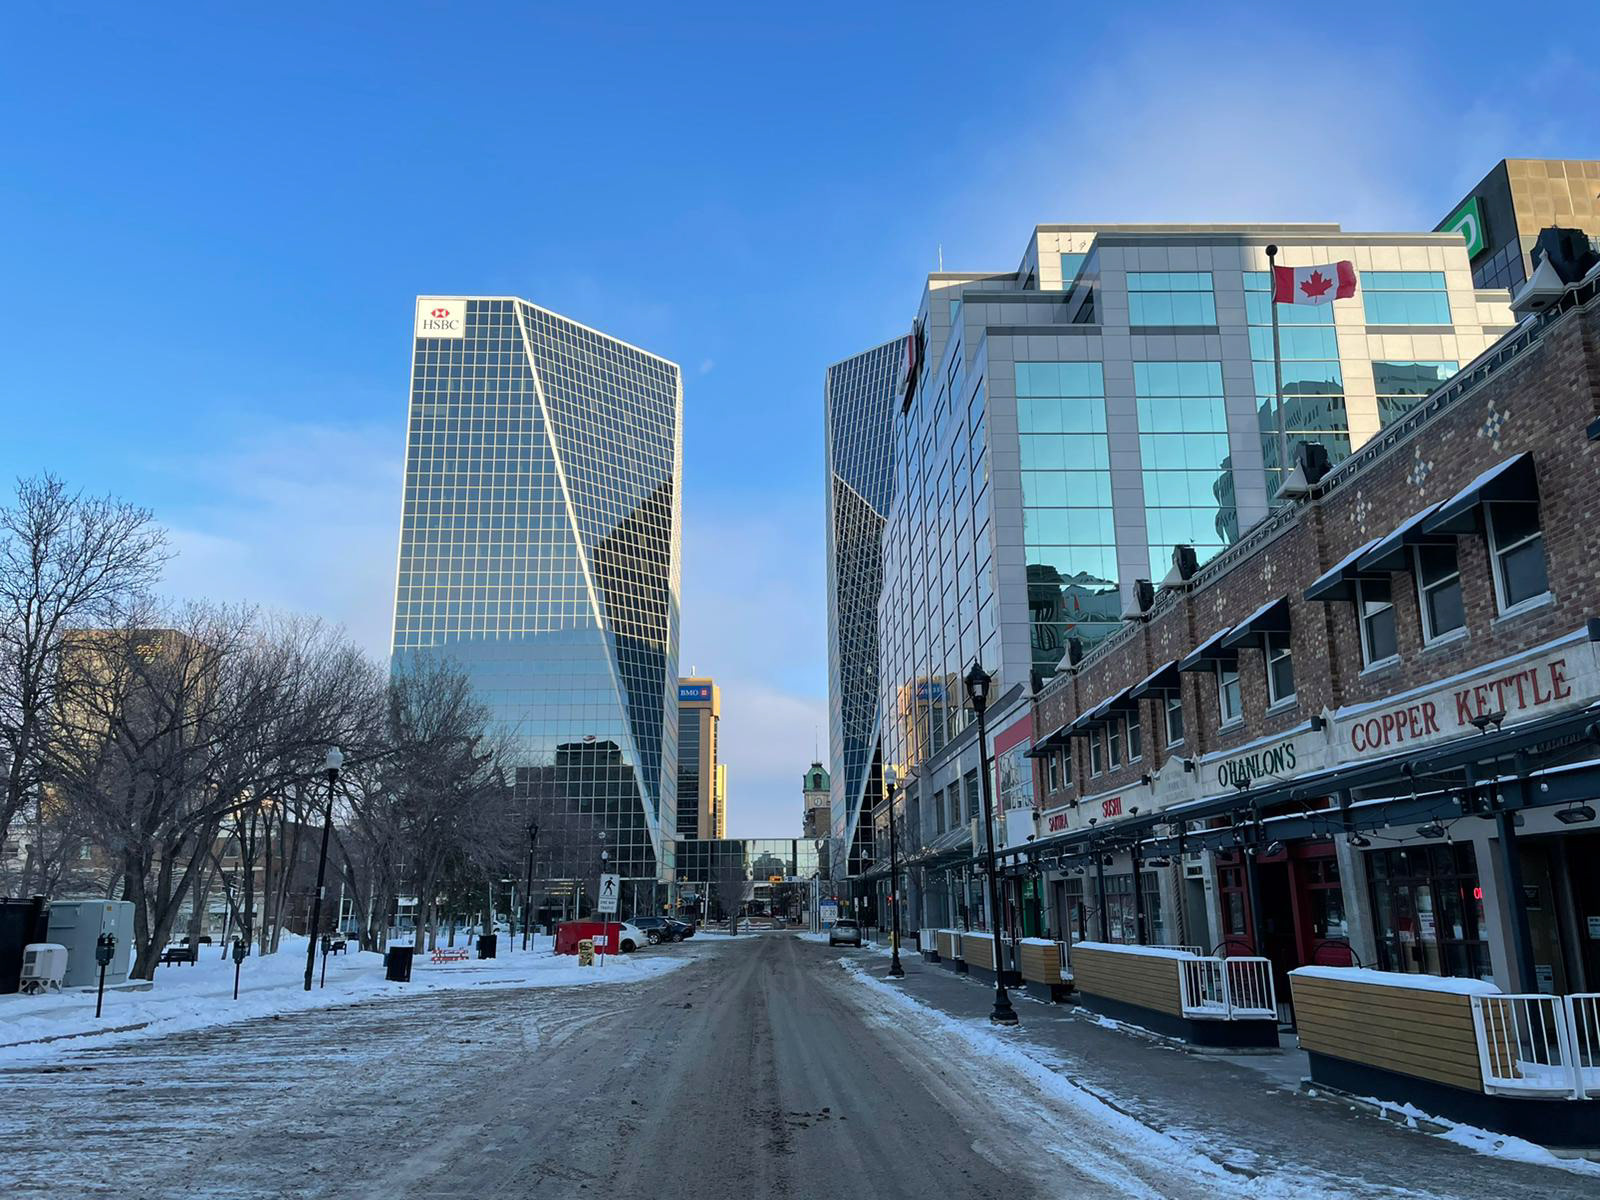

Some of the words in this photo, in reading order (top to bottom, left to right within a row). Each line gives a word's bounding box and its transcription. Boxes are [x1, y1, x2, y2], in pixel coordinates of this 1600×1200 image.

[423, 319, 459, 330] HSBC
[680, 689, 699, 697] BMO
[1351, 701, 1440, 752] COPPER
[1454, 658, 1571, 726] KETTLE
[1218, 742, 1296, 787] O'HANLON'S
[1102, 797, 1122, 818] SUSHI
